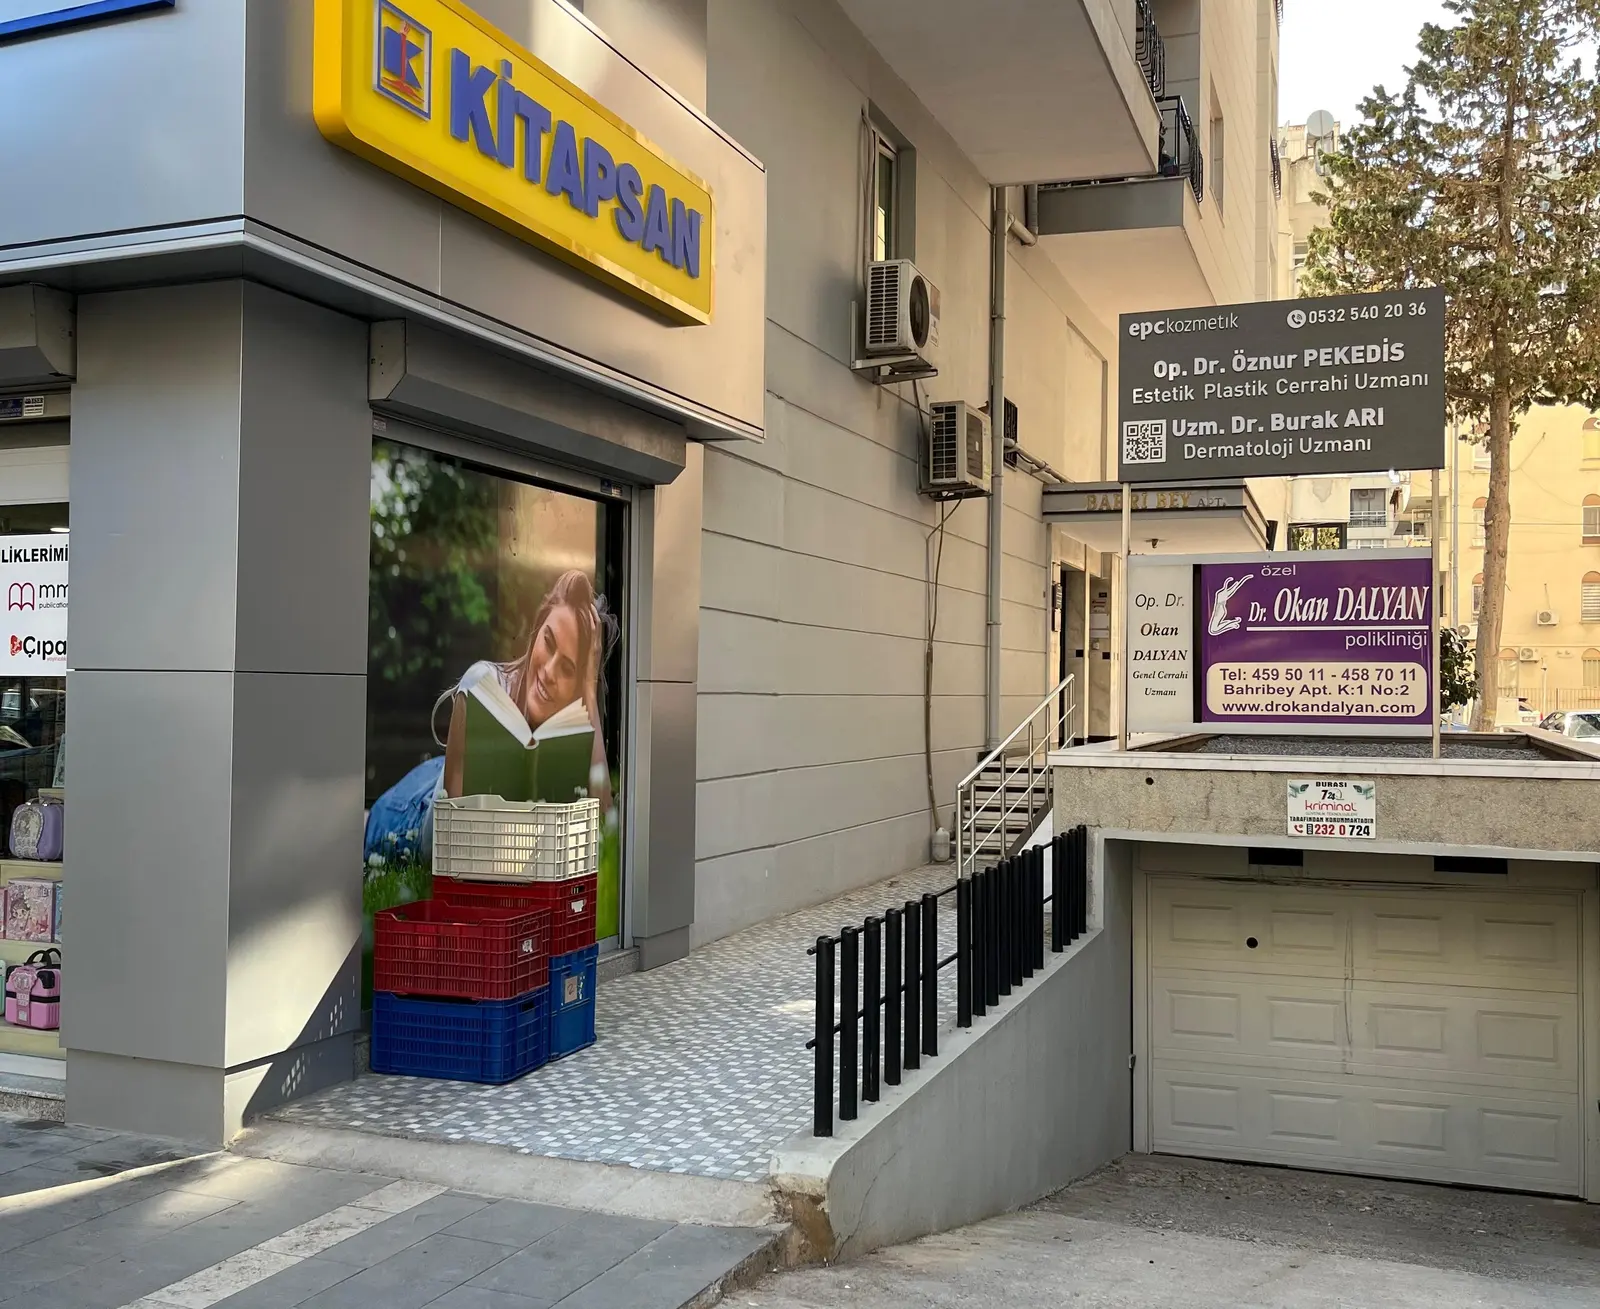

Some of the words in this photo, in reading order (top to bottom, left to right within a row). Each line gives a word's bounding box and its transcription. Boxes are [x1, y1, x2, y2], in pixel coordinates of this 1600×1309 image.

[451, 47, 700, 279] KİTAPSAN
[1308, 308, 1346, 325] 0532
[1350, 306, 1379, 322] 540
[1384, 304, 1403, 318] 20
[1408, 302, 1427, 316] 36
[1153, 360, 1188, 381] Op.
[1194, 357, 1226, 376] Dr.
[1232, 349, 1298, 372] Öznur
[1303, 338, 1405, 368] PEKEDİS
[1132, 385, 1195, 404] Estetik
[1204, 380, 1268, 400] Plastik
[1276, 375, 1348, 396] Cerrahi
[1354, 372, 1428, 390] Uzmanı
[1172, 418, 1225, 437] Uzm.
[1231, 416, 1264, 433] Dr.
[1270, 410, 1339, 432] Burak
[1344, 407, 1384, 427] ARI
[1184, 438, 1293, 460] Dermatoloji
[1299, 438, 1371, 454] Uzmanı
[1156, 492, 1191, 508] BEY
[1261, 564, 1296, 576] özel
[1135, 594, 1159, 610] Op.
[1165, 593, 1185, 607] Dr.
[1248, 602, 1267, 622] Dr.
[1274, 586, 1329, 622] Okan
[1333, 586, 1429, 622] DALYAN
[1140, 623, 1179, 636] Okan
[1345, 631, 1427, 650] polikliniği
[1133, 650, 1188, 661] DALYAN
[1132, 671, 1156, 679] Genel
[1157, 671, 1188, 679] Cerrahi
[1219, 668, 1247, 681] Tel:
[1252, 668, 1280, 681] 459
[1285, 668, 1303, 681] 50
[1309, 668, 1325, 681] 11
[1341, 668, 1369, 681] 458
[1375, 668, 1394, 681] 70
[1400, 668, 1416, 681] 11
[1144, 687, 1177, 696] Uzmanı
[1224, 684, 1295, 698] Bahribey
[1299, 684, 1332, 698] Apt.
[1338, 685, 1364, 696] K:1
[1370, 685, 1410, 696] No:2
[1222, 701, 1416, 715] www.drokandalyan.com
[1305, 800, 1357, 812] kriminal
[1314, 824, 1335, 835] 232
[1339, 824, 1346, 835] 0
[1349, 825, 1370, 836] 724
